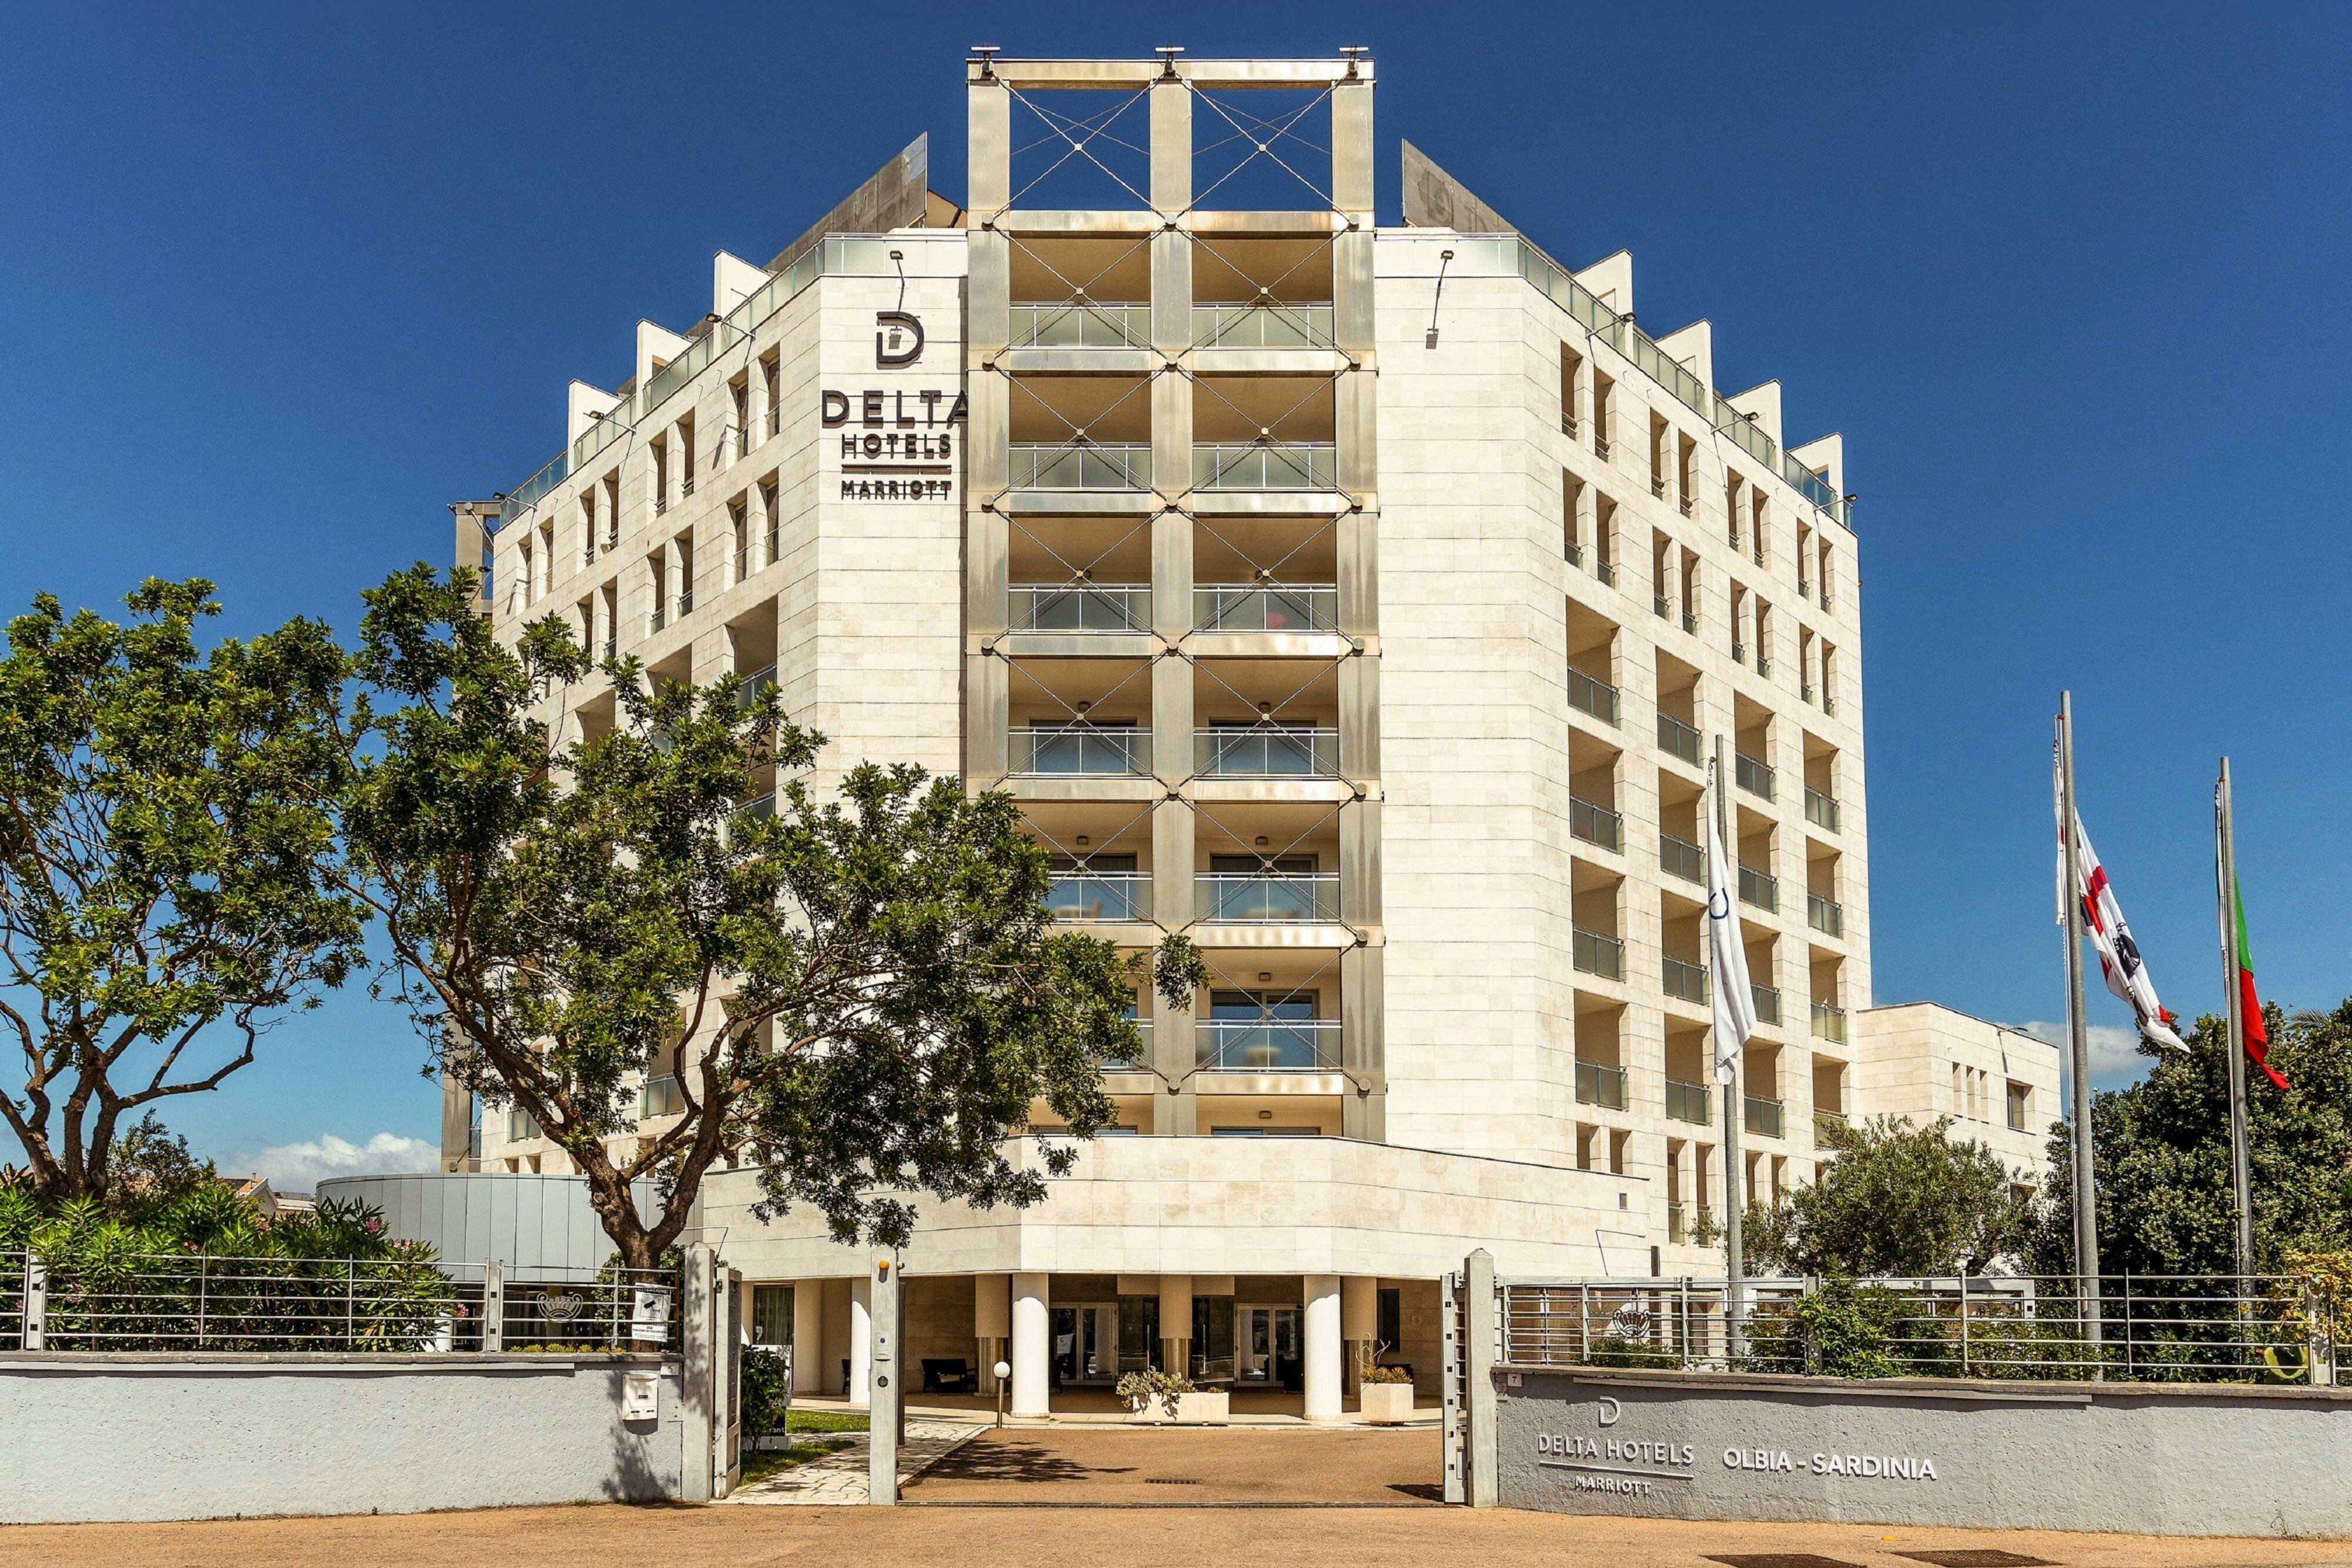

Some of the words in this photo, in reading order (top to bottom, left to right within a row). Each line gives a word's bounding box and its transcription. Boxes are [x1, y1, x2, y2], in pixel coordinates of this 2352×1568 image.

[822, 390, 968, 425] DELTA
[841, 433, 951, 456] HOTELS
[841, 480, 951, 498] MARRIOTT
[668, 1365, 673, 1373] 5
[1538, 1434, 1598, 1456] DELTA
[1606, 1439, 1694, 1464] HOTELS
[1722, 1447, 1792, 1472] OLBIA
[1812, 1453, 1937, 1480] SARDINIA
[1575, 1475, 1652, 1495] MARRIOTT
